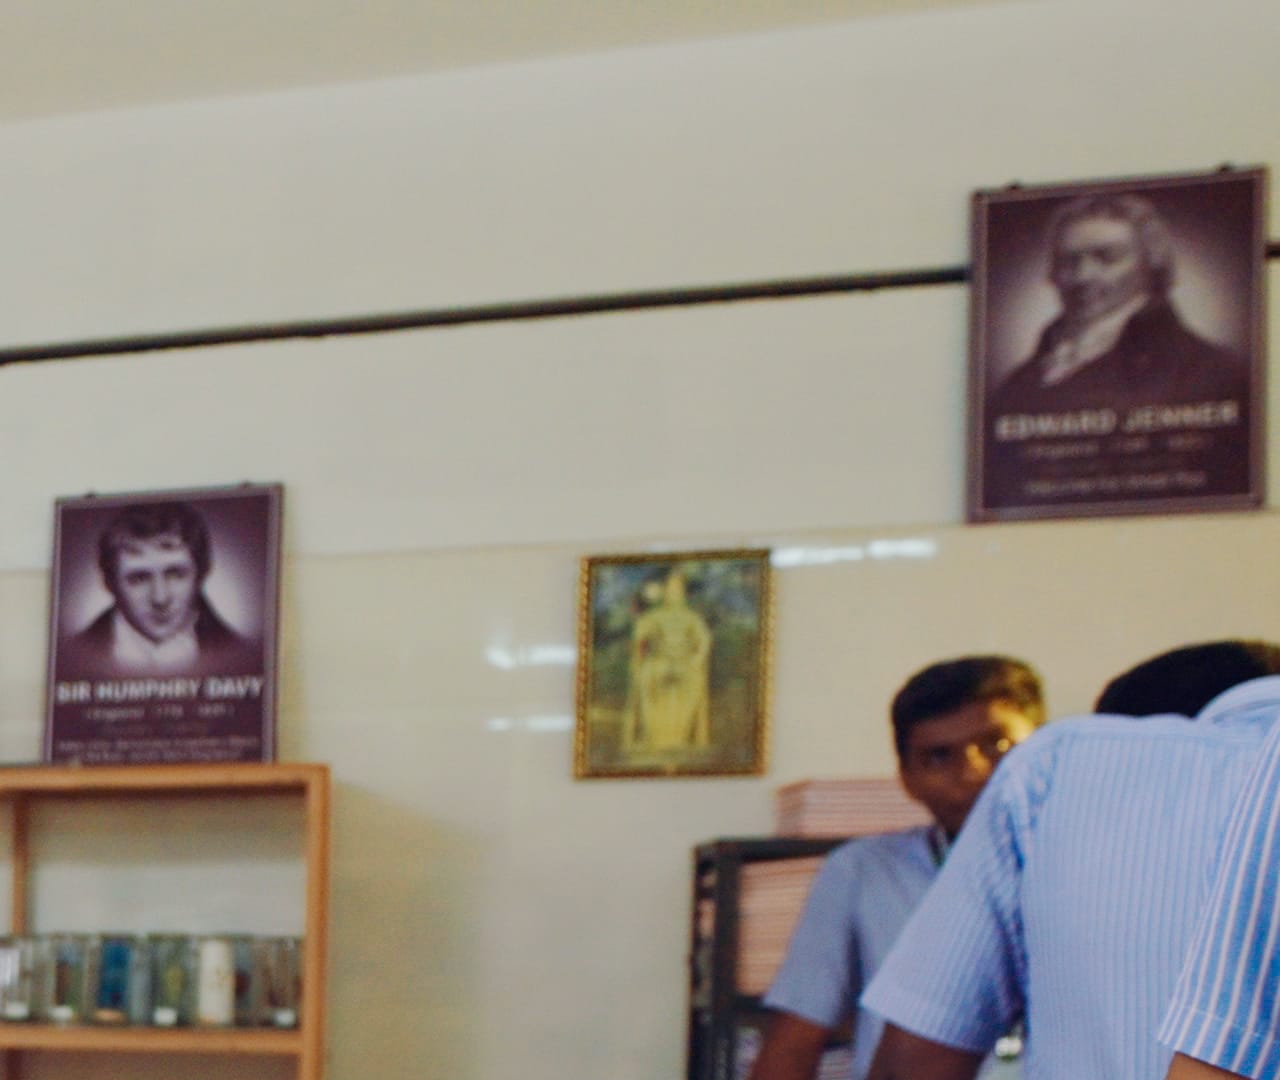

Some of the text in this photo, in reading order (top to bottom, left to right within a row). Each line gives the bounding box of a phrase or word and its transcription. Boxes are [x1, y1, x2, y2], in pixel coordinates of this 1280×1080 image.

[994, 401, 1239, 441] EDWARD JENNER
[56, 676, 264, 702] SIR HUMPHRY DAVY
